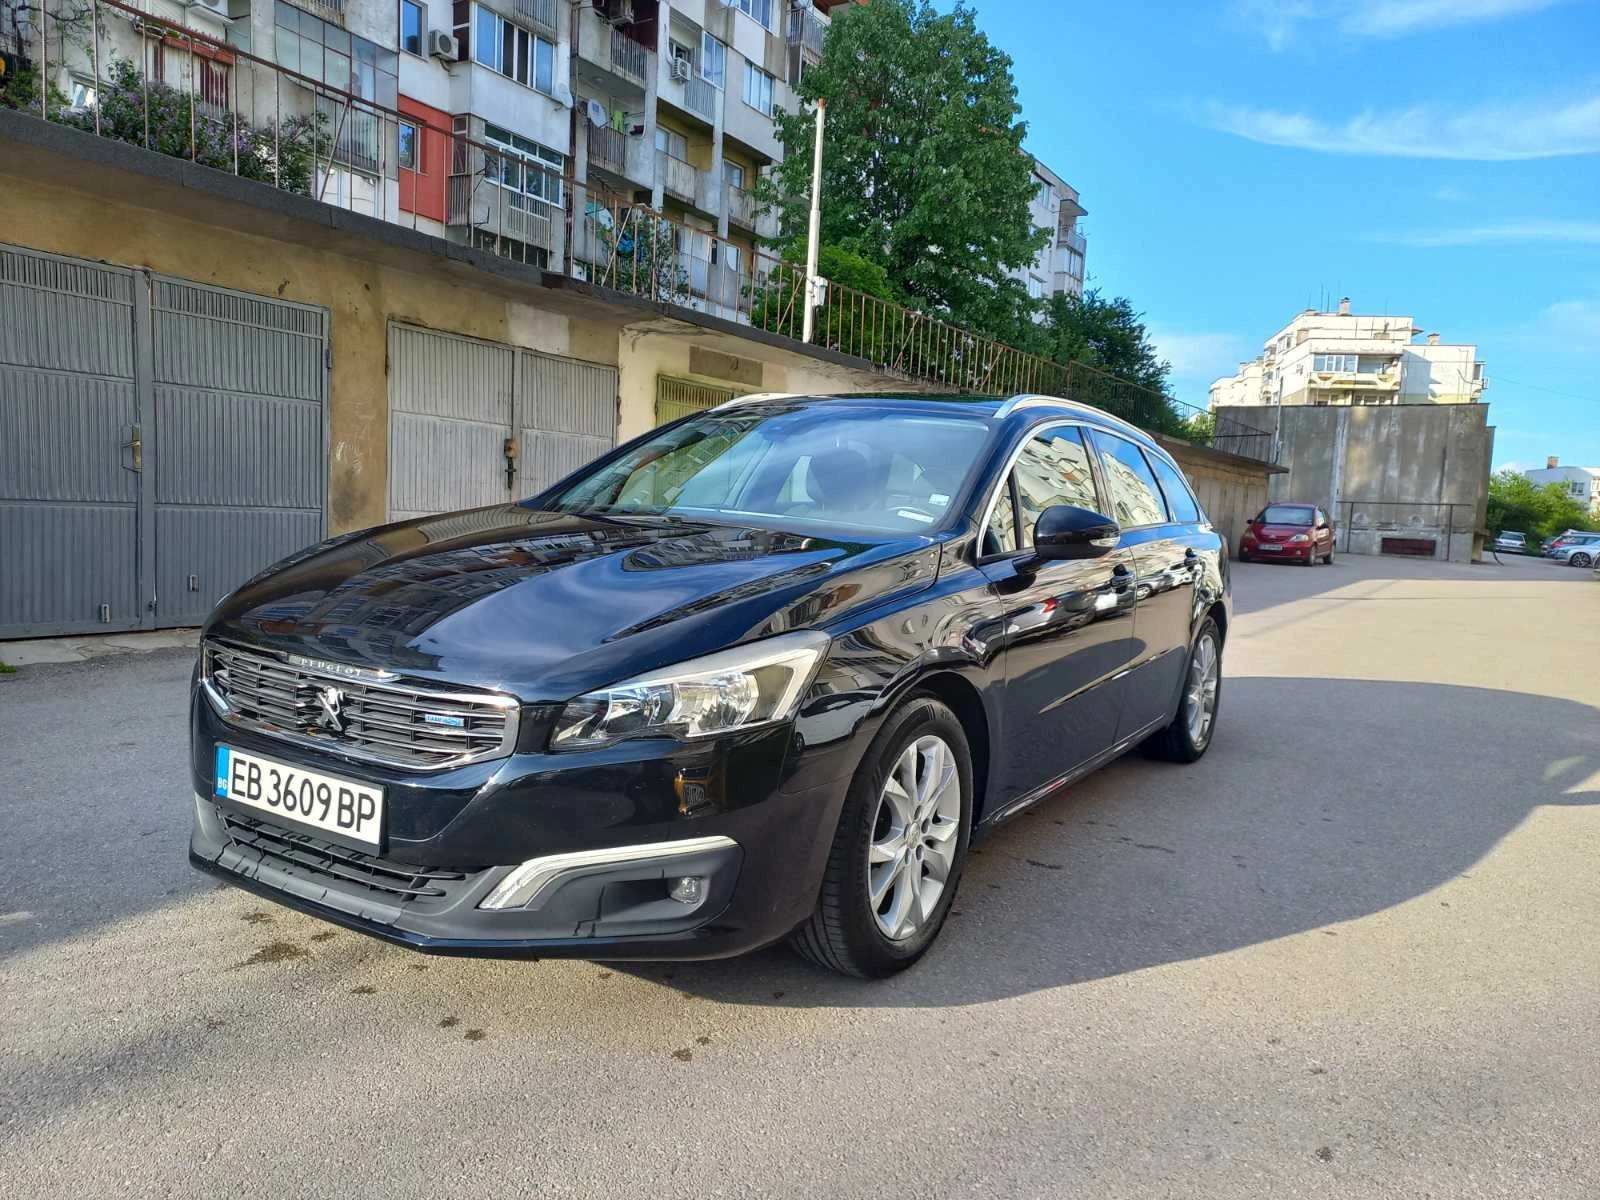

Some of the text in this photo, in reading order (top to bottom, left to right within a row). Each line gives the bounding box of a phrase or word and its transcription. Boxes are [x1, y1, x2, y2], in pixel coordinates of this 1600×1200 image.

[300, 658, 362, 676] PEUGEOT
[217, 777, 228, 790] BG
[231, 757, 376, 832] EB 3609 BP
